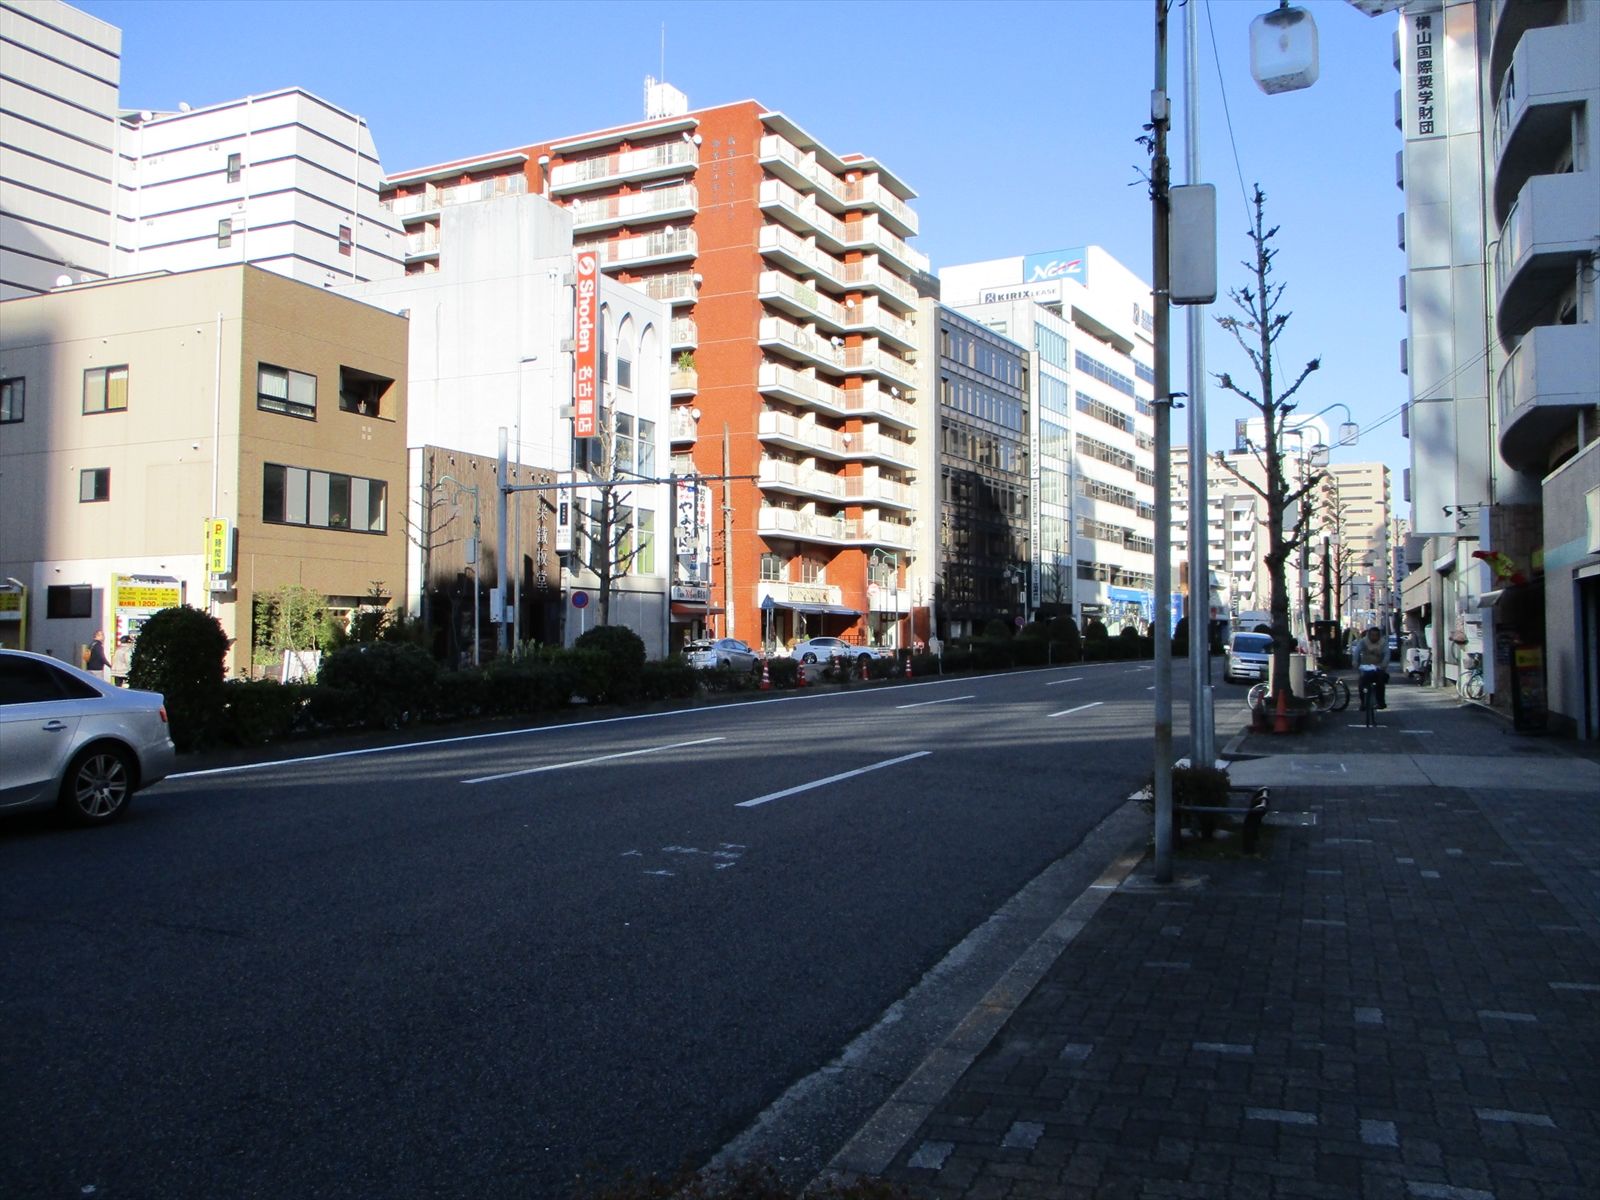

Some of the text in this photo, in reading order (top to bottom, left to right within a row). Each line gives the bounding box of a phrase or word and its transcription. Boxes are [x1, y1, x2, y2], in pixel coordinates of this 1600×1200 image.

[1416, 16, 1434, 134] 横山国際奨学財団
[998, 290, 1029, 301] KIRIX
[578, 280, 594, 432] Shoden 名古屋店
[215, 524, 222, 534] P
